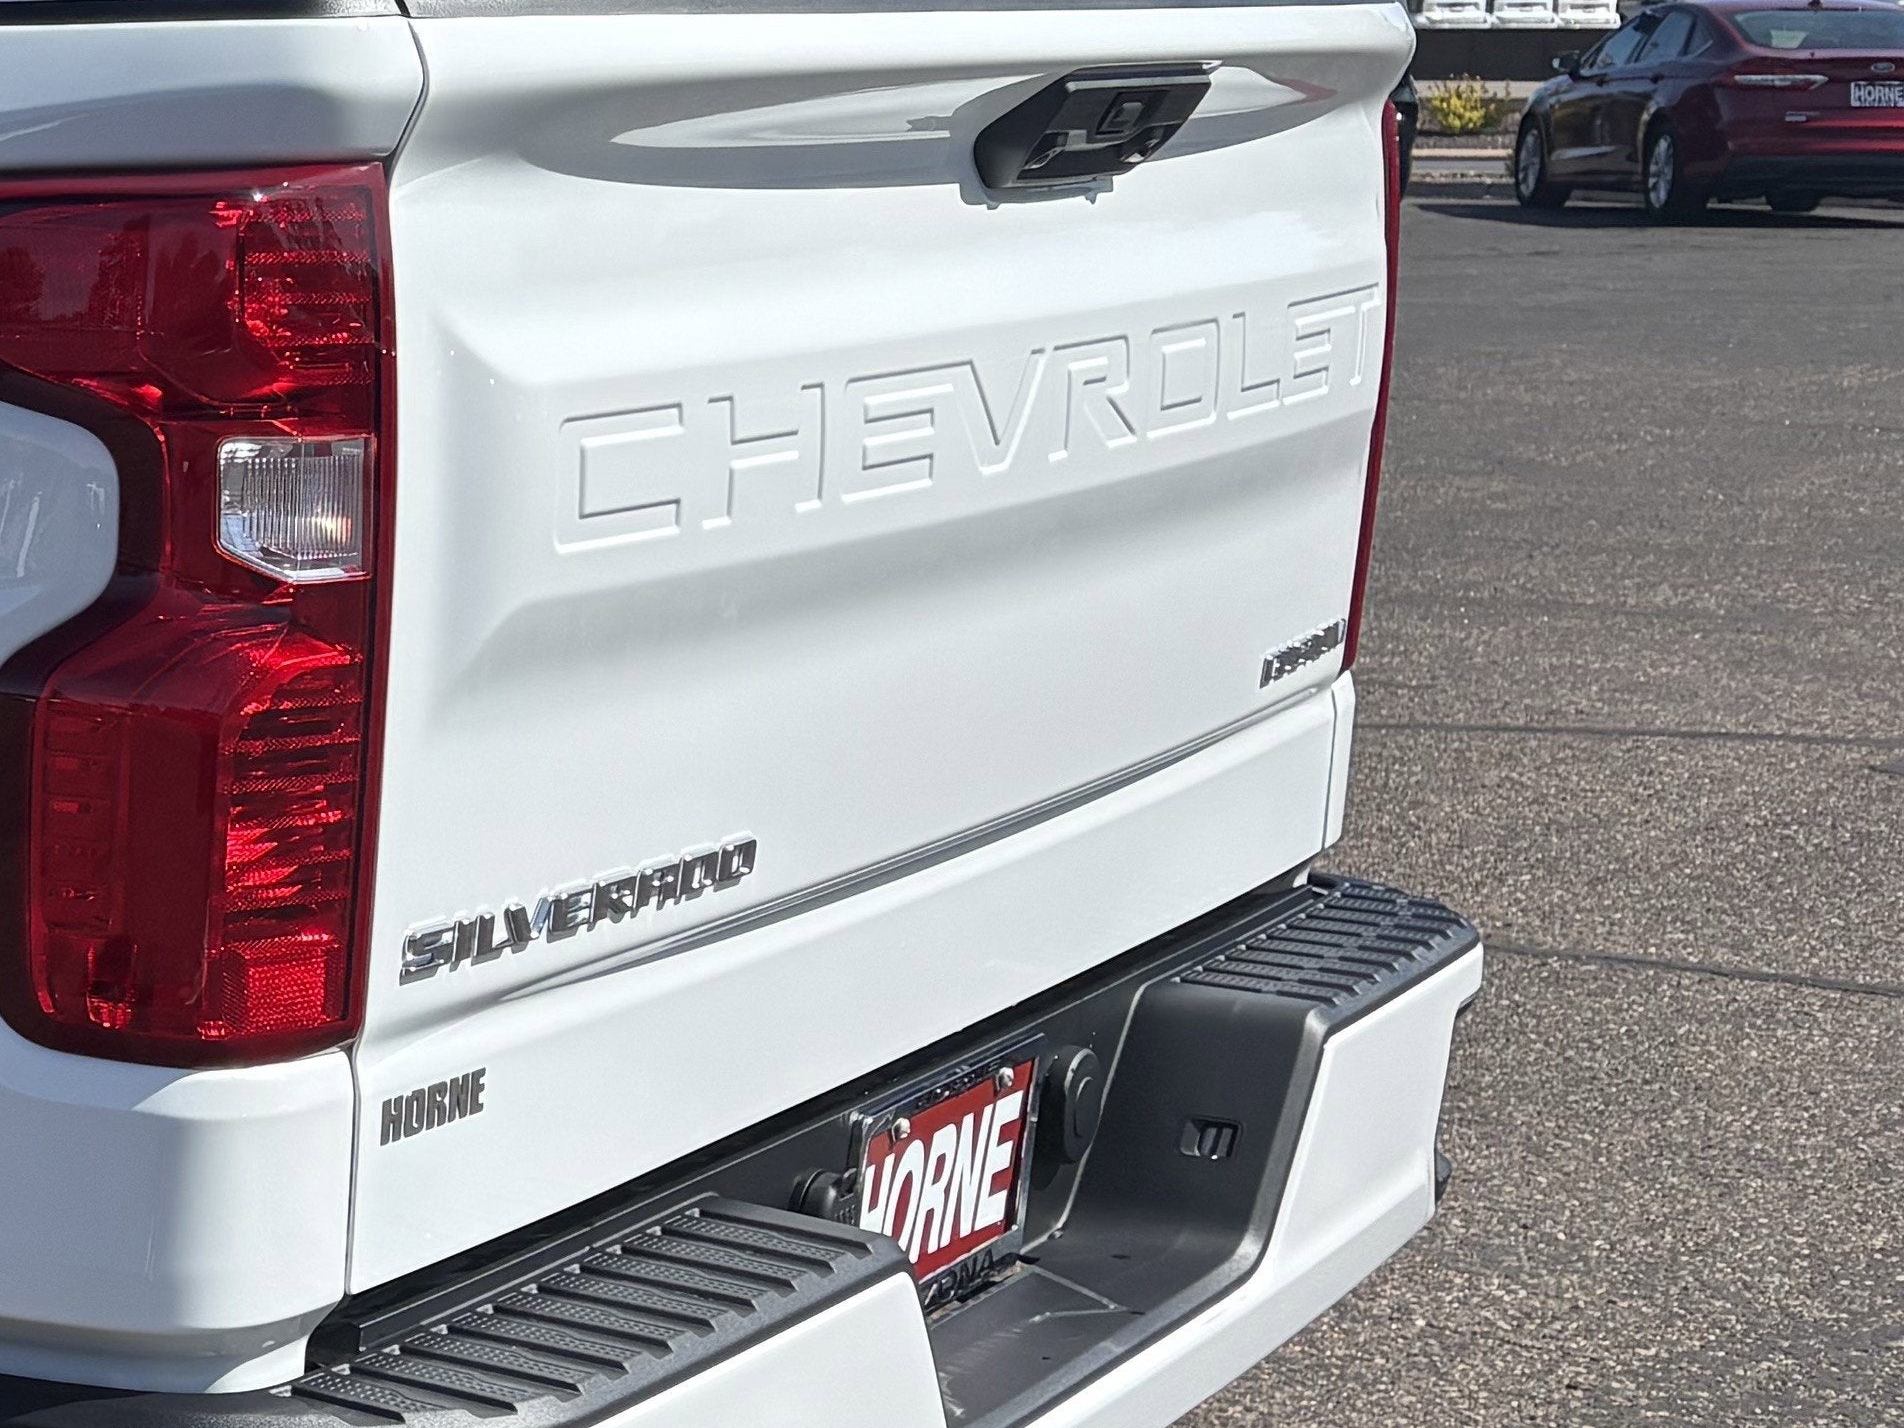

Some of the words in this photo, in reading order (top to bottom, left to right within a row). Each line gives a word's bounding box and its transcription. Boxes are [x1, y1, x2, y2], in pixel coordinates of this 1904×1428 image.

[554, 283, 1381, 554] CHEVROLET
[399, 832, 758, 984] SILVERADO
[380, 1068, 486, 1147] HORNE
